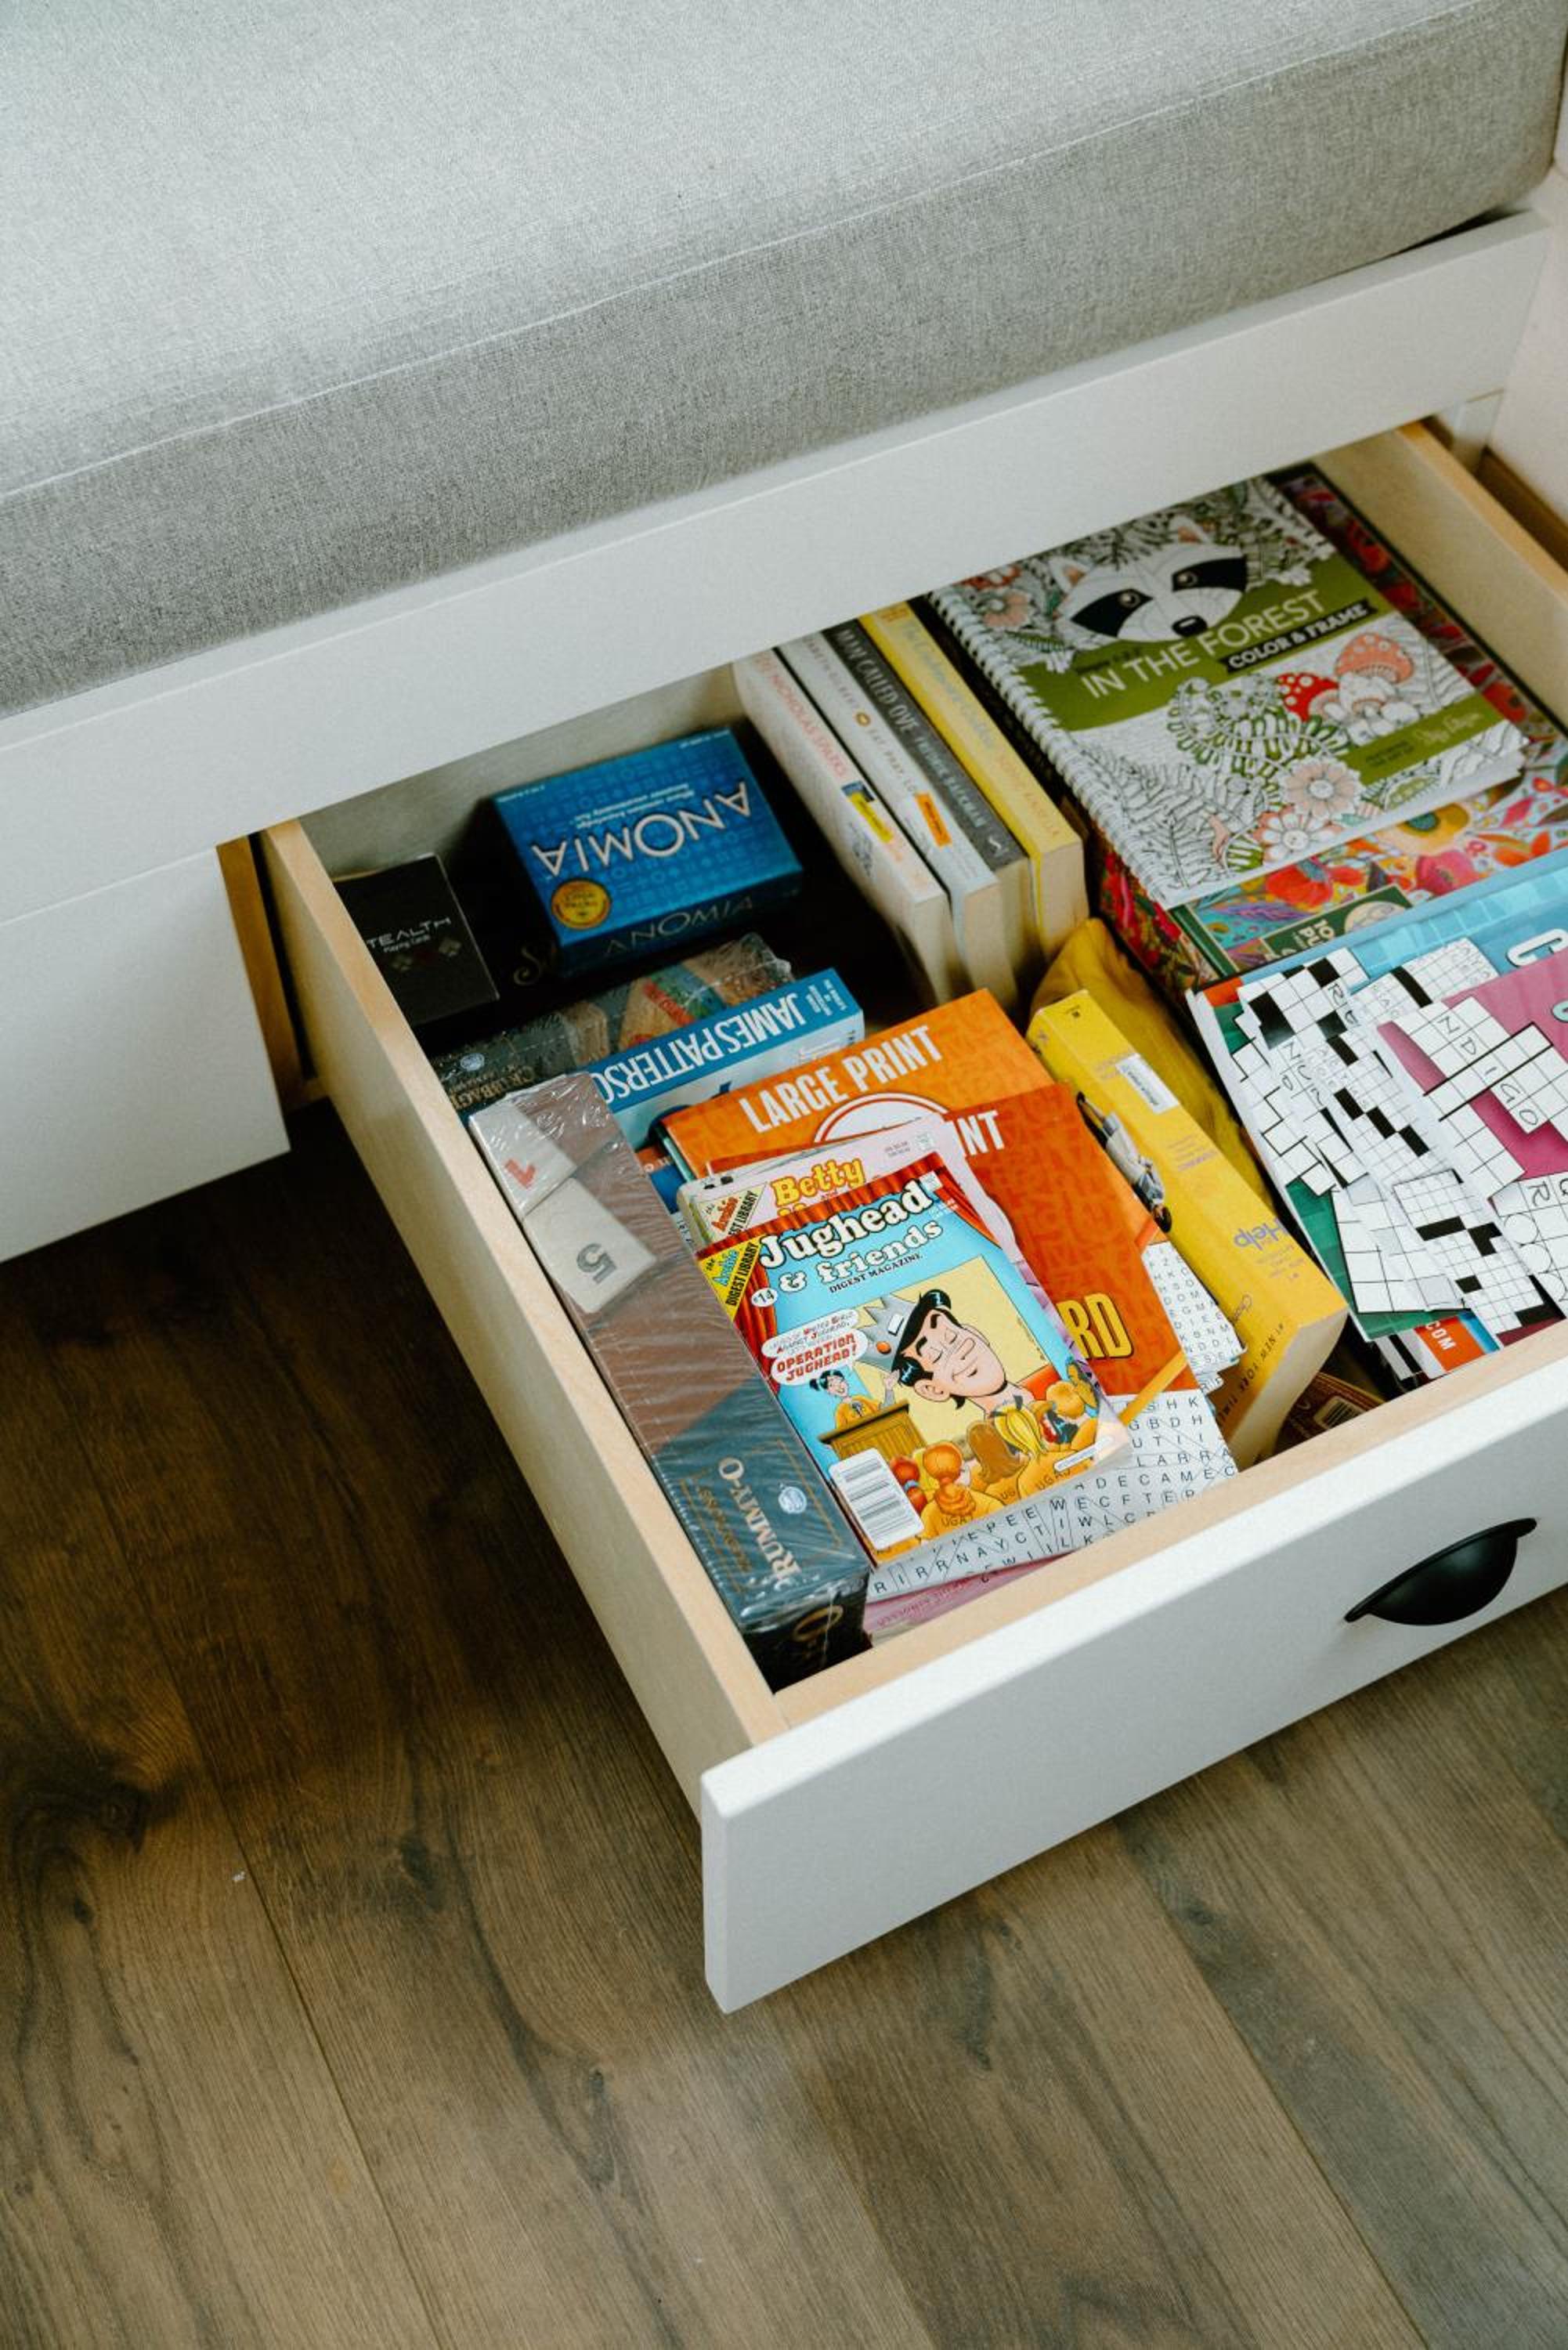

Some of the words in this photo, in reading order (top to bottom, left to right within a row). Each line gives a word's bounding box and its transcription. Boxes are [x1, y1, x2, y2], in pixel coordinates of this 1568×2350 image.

[1082, 668, 1126, 698] IN
[1123, 641, 1199, 682] THE
[1198, 589, 1324, 656] FOREST
[1229, 638, 1288, 669] COLOR
[1290, 632, 1307, 647] &
[1306, 604, 1368, 639] FRAME
[835, 628, 866, 660] MAN
[862, 657, 900, 705] CALLED
[888, 703, 919, 732] OVE
[531, 781, 752, 877] ANOMIA
[604, 895, 753, 957] ANOMIA
[719, 992, 805, 1050] JAMES
[738, 1065, 843, 1133] LARGE
[842, 1025, 944, 1093] PRINT
[737, 1190, 759, 1219] LIBRARY
[770, 1159, 866, 1207] Betty
[760, 1178, 934, 1269] Jughead
[1233, 1218, 1287, 1251] Help
[576, 1242, 617, 1285] 5
[724, 1274, 747, 1306] DIGEST
[737, 1242, 760, 1275] LIBRARY
[779, 1270, 807, 1292] &
[815, 1220, 943, 1284] friends
[829, 1274, 869, 1294] DIGEST
[870, 1253, 923, 1278] MAGAZINE
[777, 1332, 856, 1373] OPERATION
[786, 1343, 857, 1381] JUGHEAD!
[718, 1457, 802, 1580] RUMMY-O
